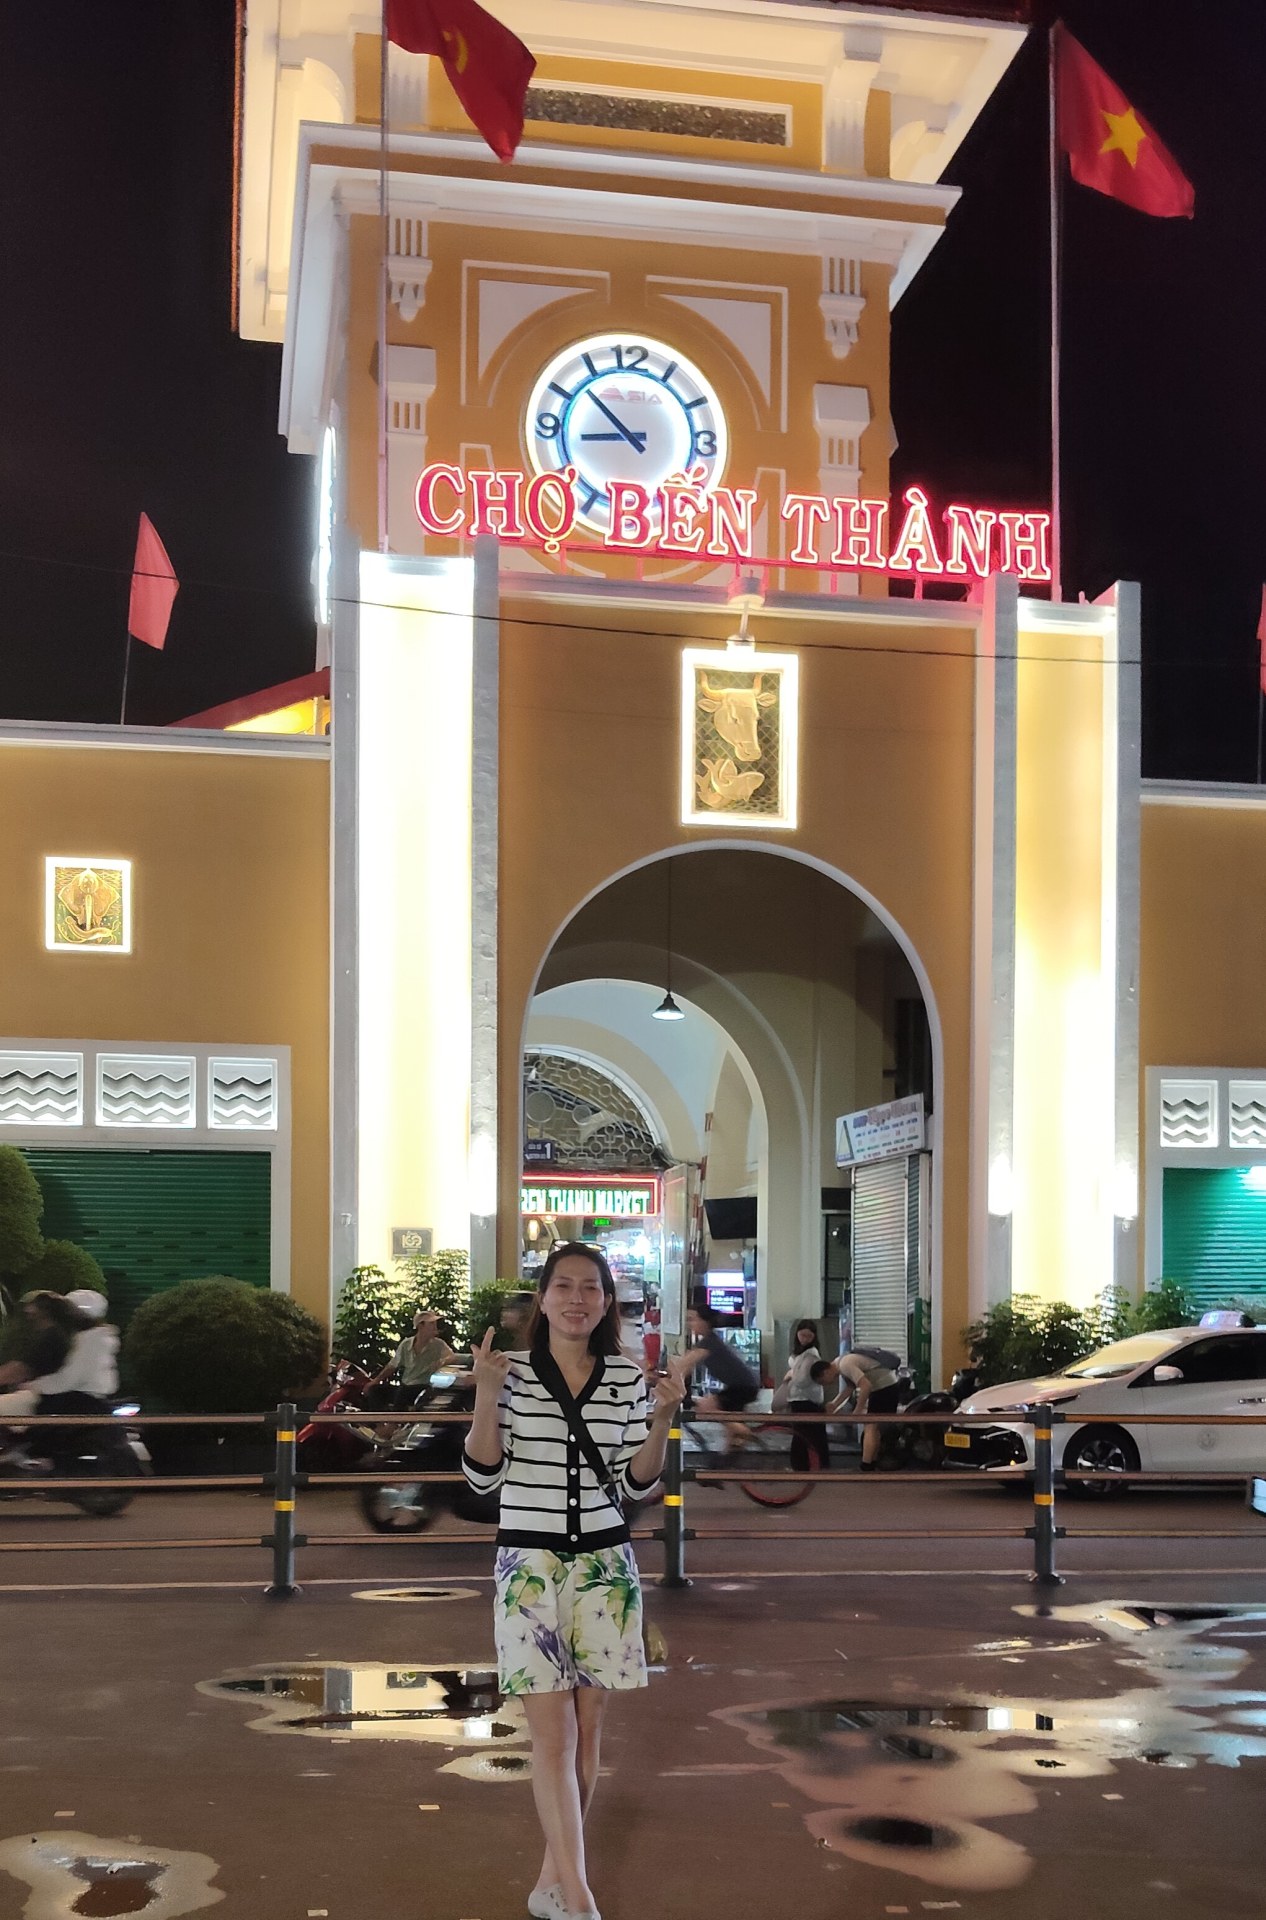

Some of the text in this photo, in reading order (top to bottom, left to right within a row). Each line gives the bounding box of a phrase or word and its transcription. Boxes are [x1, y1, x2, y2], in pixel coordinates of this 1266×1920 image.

[611, 345, 649, 372] 12
[535, 412, 561, 439] 9
[695, 430, 718, 456] 3
[415, 463, 1052, 580] CHỢ BẾN THÀNH
[548, 1188, 594, 1214] THANH
[595, 1189, 650, 1215] MARKET
